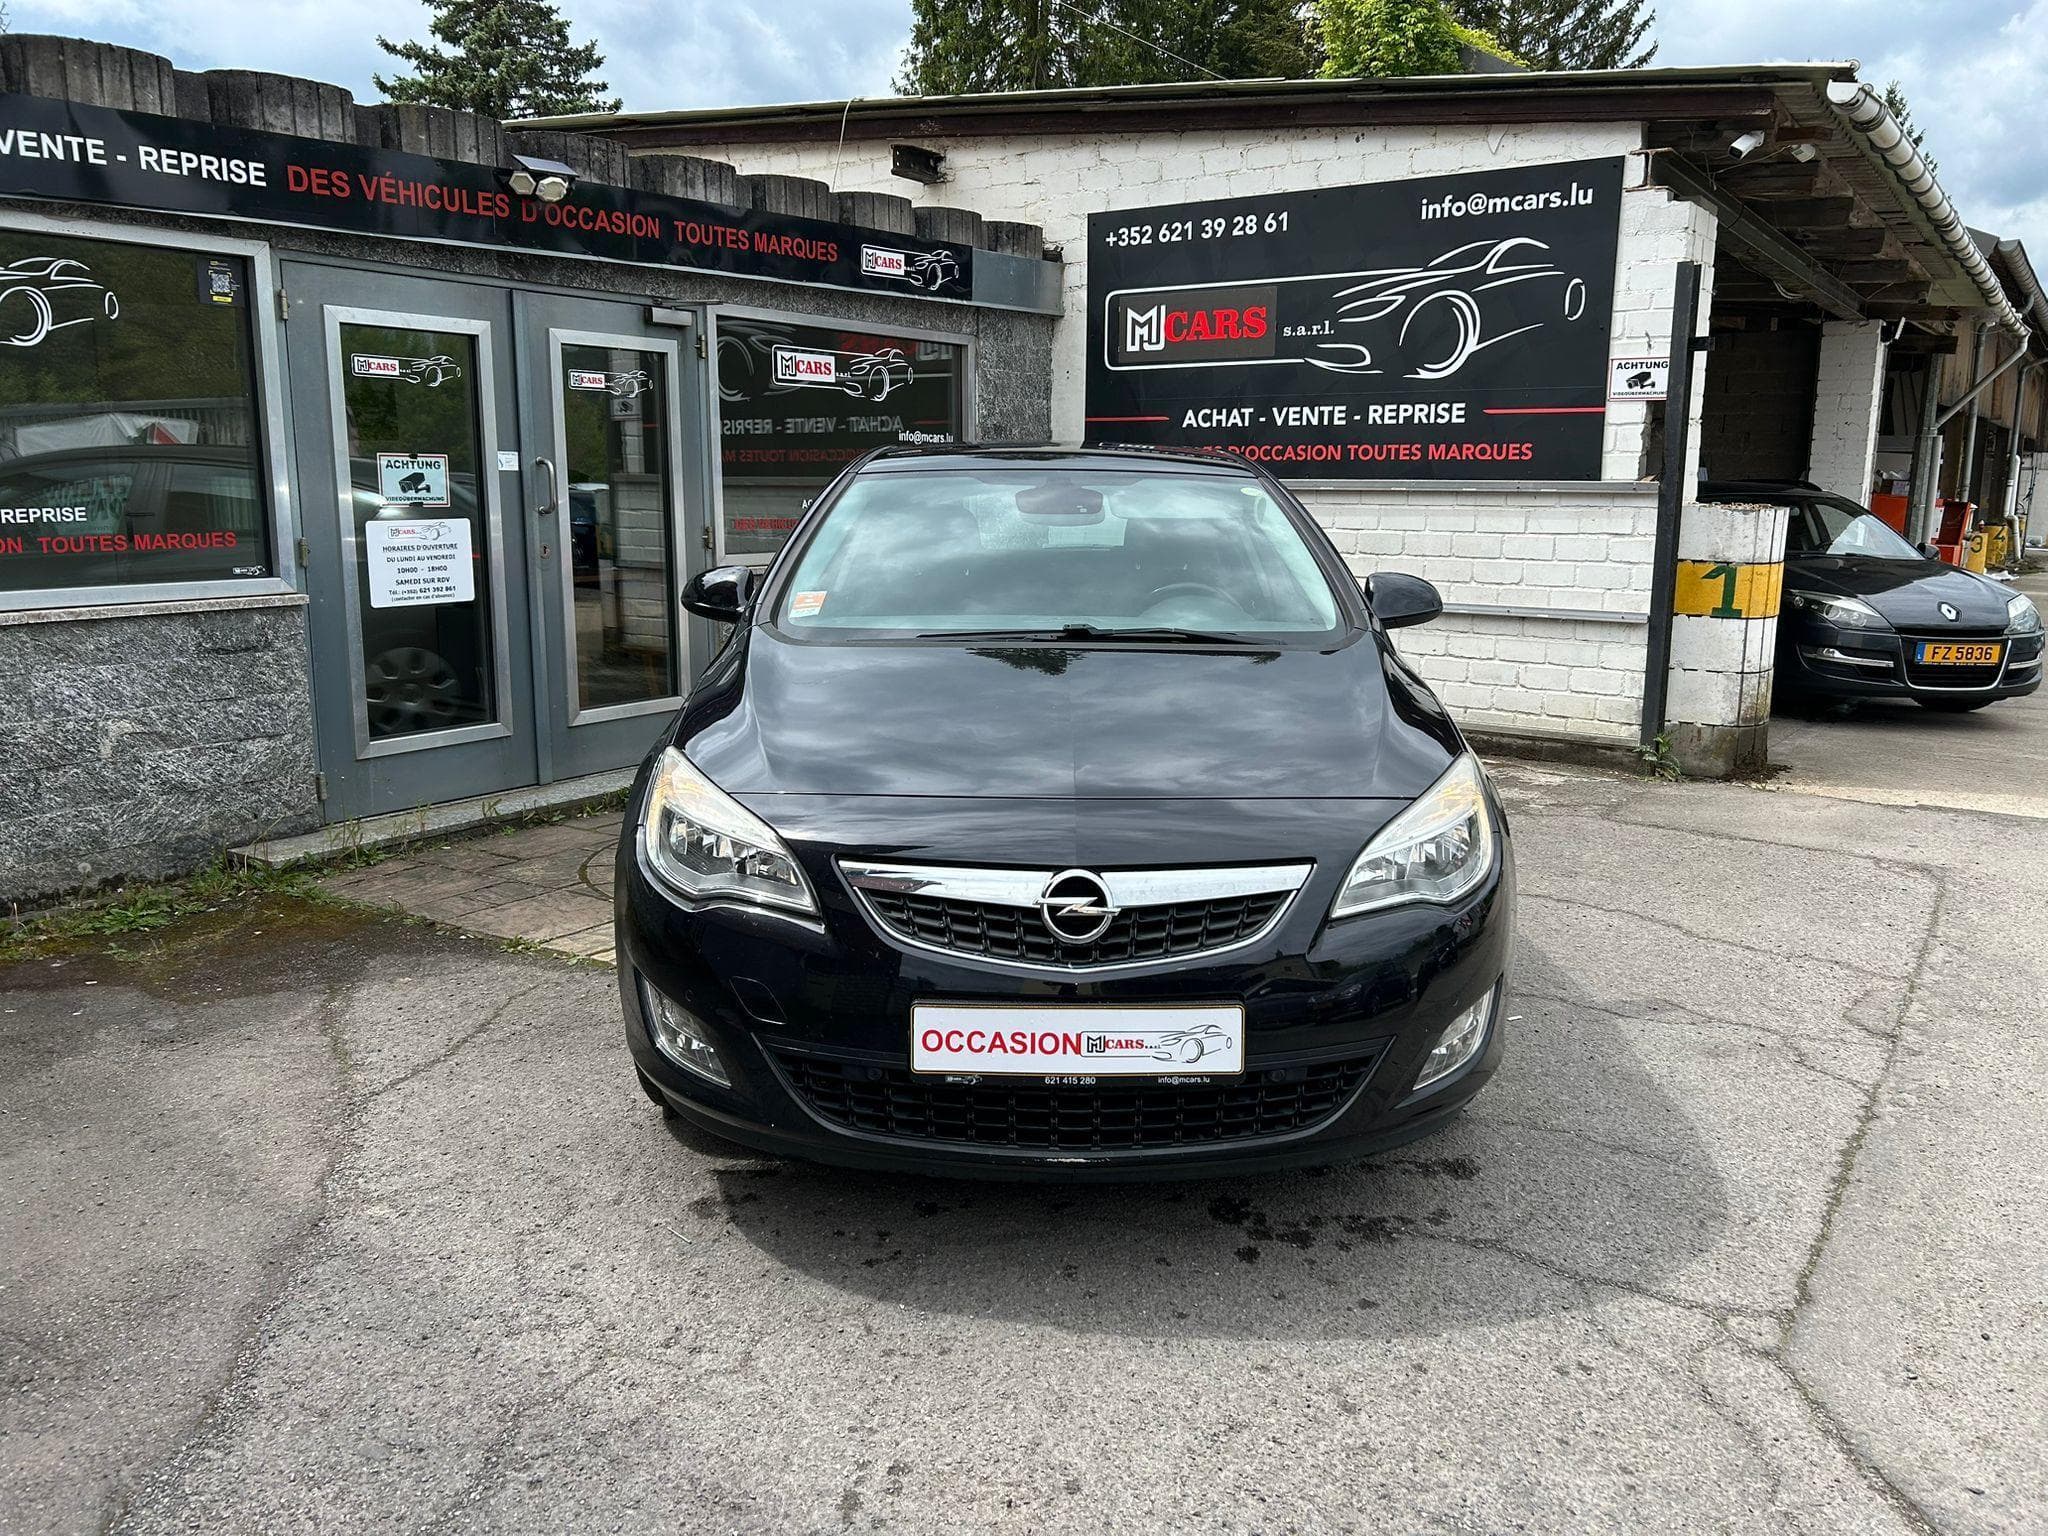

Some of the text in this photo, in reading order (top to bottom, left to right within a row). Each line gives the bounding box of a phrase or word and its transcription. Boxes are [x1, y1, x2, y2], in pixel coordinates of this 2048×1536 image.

[0, 129, 107, 165] VENTE
[139, 145, 266, 186] REPRISE
[287, 164, 350, 198] DES
[359, 172, 509, 218] VÉHICULES
[674, 219, 749, 250] TOUTES
[755, 231, 838, 262] MARQUES
[1421, 182, 1593, 219] info@mcars.lu
[1105, 211, 1288, 247] +352 621 39 28 61
[1283, 320, 1335, 337] s.a.r.l.
[1616, 360, 1669, 370] ACHTUNG
[1182, 407, 1253, 428] ACHAT
[1272, 405, 1346, 426] VENTE
[1368, 402, 1466, 425] REPRISE
[898, 429, 954, 445] info@mcars.lu
[1347, 445, 1422, 461] TOUTES
[1427, 442, 1533, 461] MARQUES
[385, 460, 441, 470] ACHTUNG
[0, 507, 87, 524] REPRISE
[37, 534, 128, 554] TOUTES
[133, 532, 238, 551] MARQUES
[416, 543, 458, 551] D'OUVERTURE
[1971, 535, 1983, 553] 3
[395, 578, 421, 586] SAMEDI
[1701, 565, 1742, 618] 1
[1931, 646, 1993, 660] FZ 5836
[921, 1029, 1080, 1055] OCCASION
[1045, 1077, 1096, 1085] 621 415 280
[1158, 1076, 1210, 1086] info@mcars.lu
